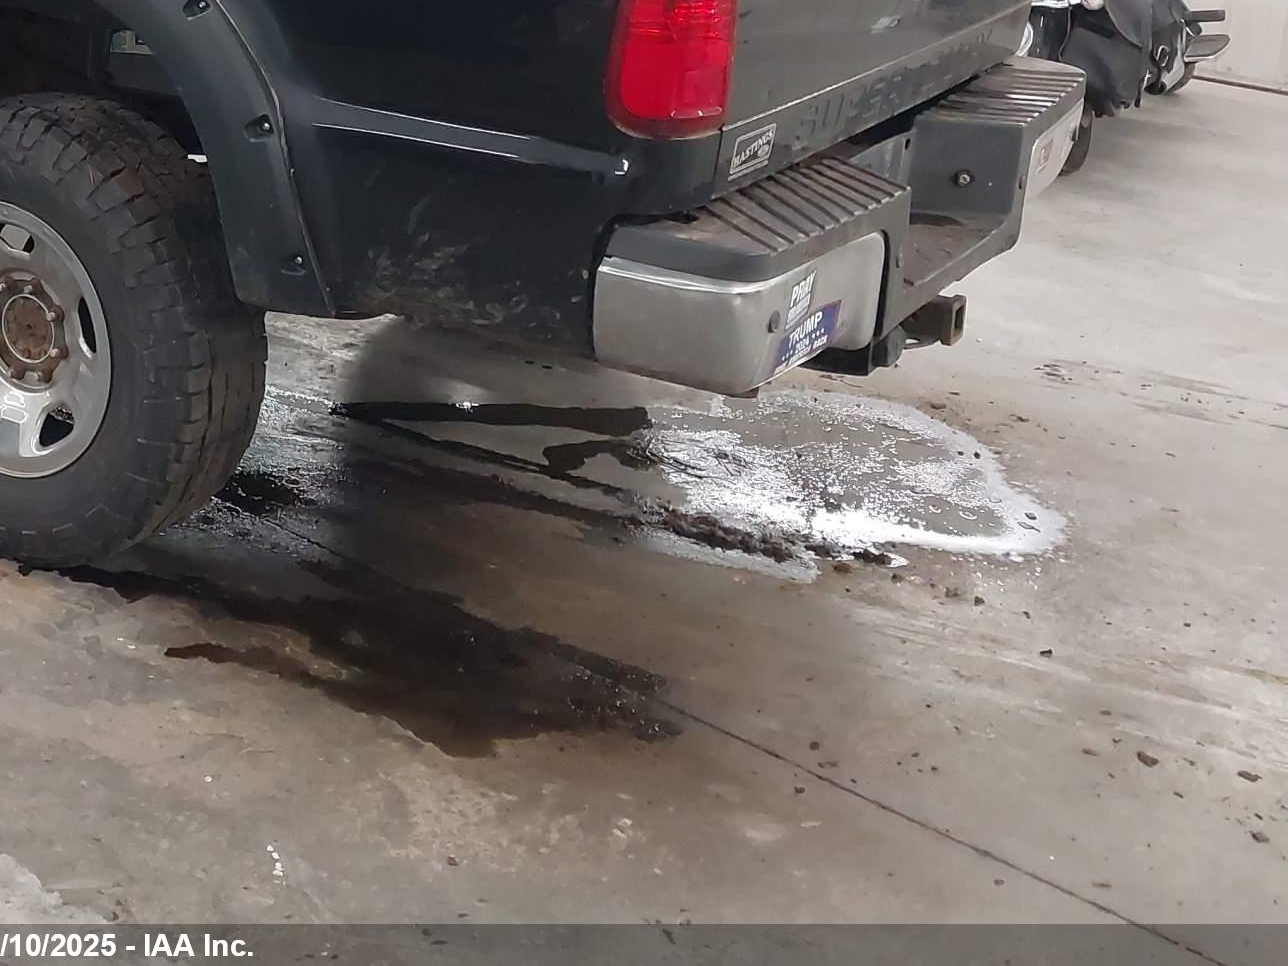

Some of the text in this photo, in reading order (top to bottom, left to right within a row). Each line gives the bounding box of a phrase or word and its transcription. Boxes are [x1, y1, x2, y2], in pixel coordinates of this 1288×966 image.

[730, 129, 774, 168] HASTINGS
[790, 270, 817, 308] PRAY
[788, 311, 824, 349] TRUMP
